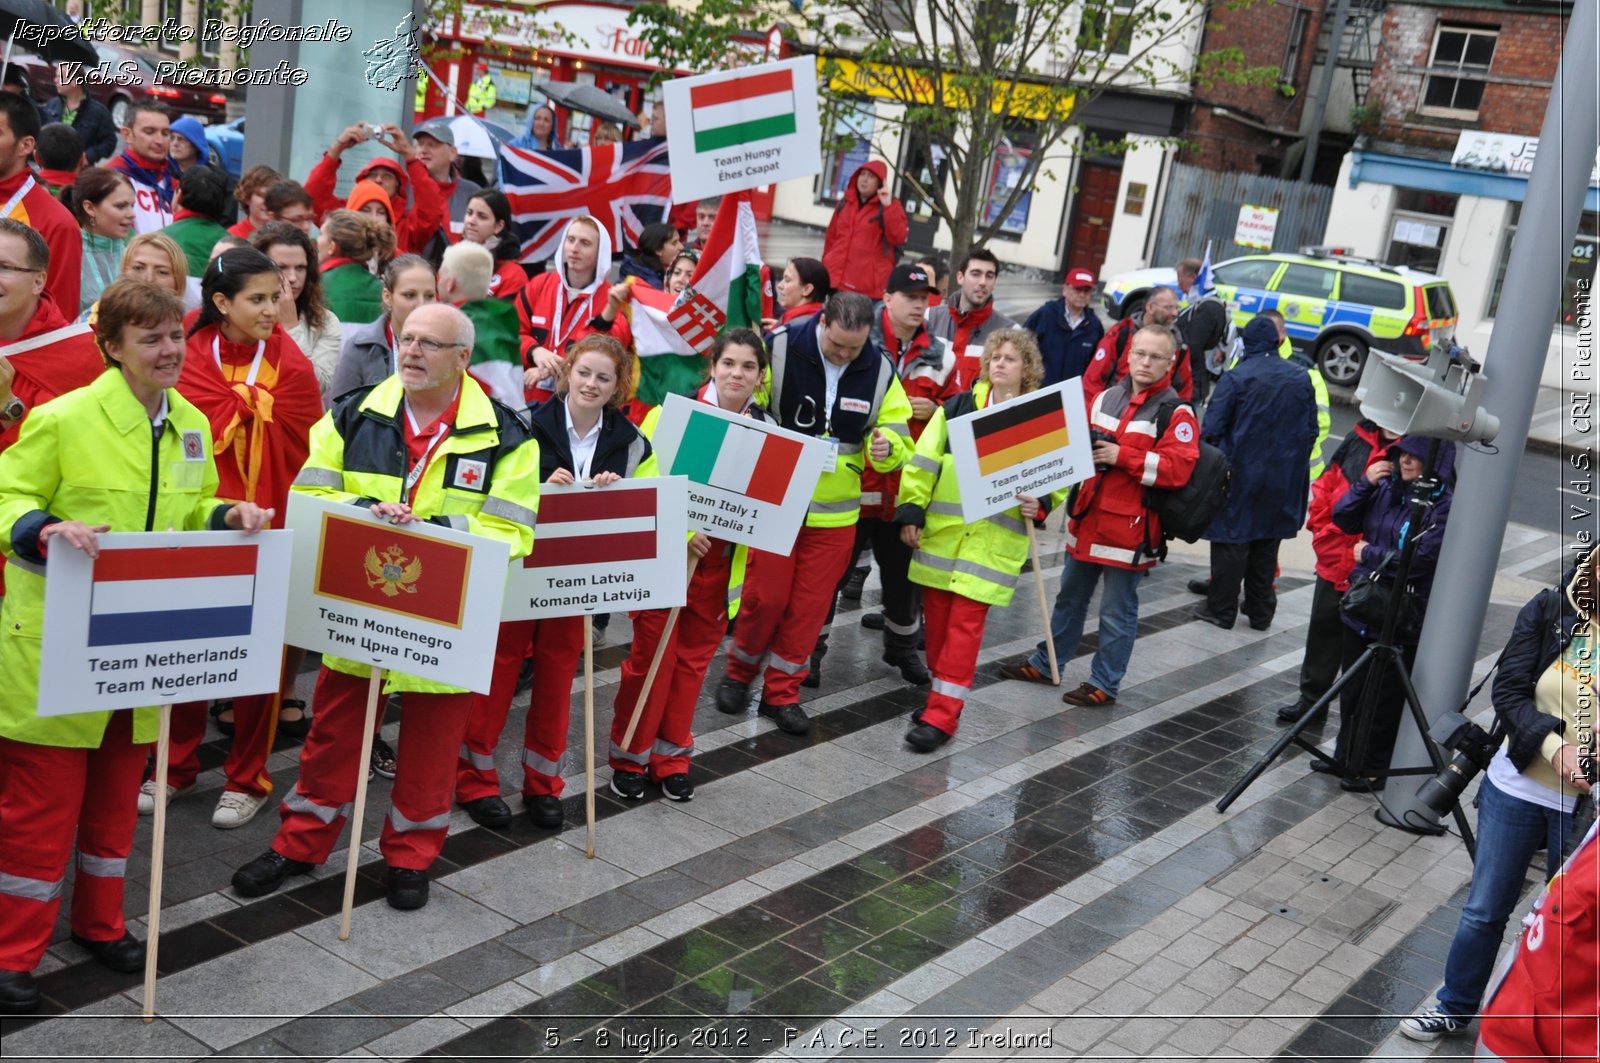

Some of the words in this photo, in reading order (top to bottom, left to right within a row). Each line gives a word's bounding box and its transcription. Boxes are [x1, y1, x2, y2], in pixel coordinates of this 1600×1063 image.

[713, 155, 743, 168] Team
[744, 146, 782, 161] Hungry
[718, 168, 744, 181] Éhes
[745, 160, 780, 176] Csapat
[1238, 220, 1274, 232] PARKING
[1252, 212, 1265, 222] NO
[991, 473, 1019, 489] Team
[1021, 456, 1065, 479] Germany
[985, 490, 1013, 506] Team
[1015, 465, 1075, 495] Deutschland
[718, 500, 749, 518] Italy
[751, 509, 759, 519] 1
[711, 514, 744, 532] Italia
[746, 525, 755, 535] 1
[546, 576, 587, 589] Team
[591, 571, 635, 586] Latvia
[530, 592, 598, 609] Komanda
[603, 588, 651, 602] Latvija
[318, 607, 359, 627] Team
[363, 618, 453, 650] Montenegro
[327, 628, 355, 646] Тим
[360, 636, 399, 656] Црна
[403, 647, 440, 666] Гора
[88, 657, 139, 673] Team
[144, 646, 248, 668] Netherlands
[95, 680, 145, 695] Team
[151, 668, 238, 690] Nederland
